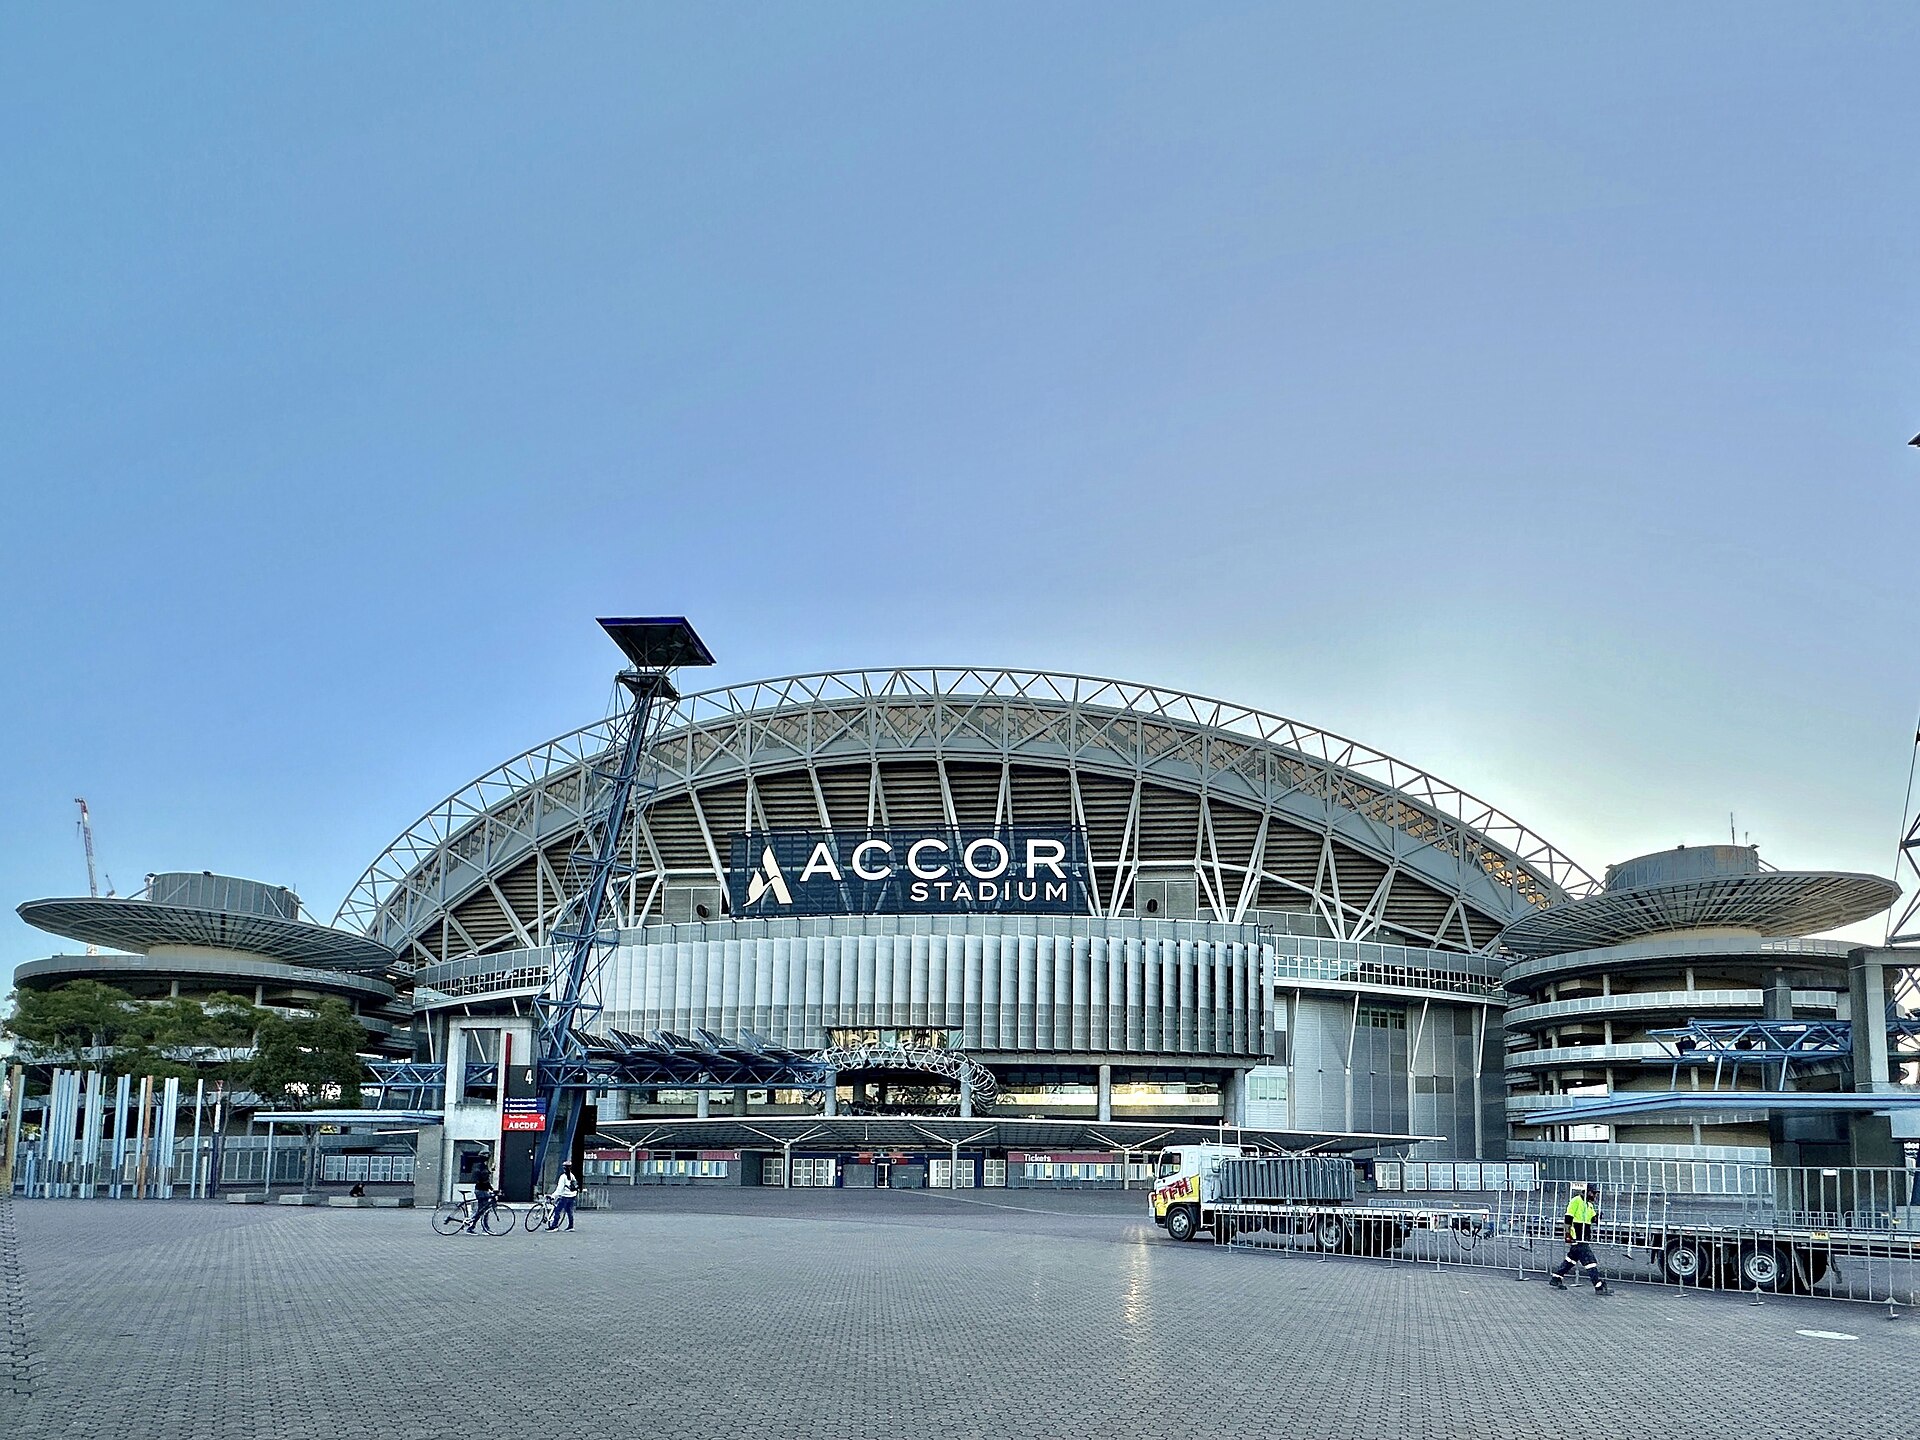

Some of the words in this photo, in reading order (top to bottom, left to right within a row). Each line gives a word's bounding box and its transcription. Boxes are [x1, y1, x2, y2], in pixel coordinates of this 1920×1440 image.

[800, 838, 1067, 882] ACCOR
[910, 882, 1067, 902] STADIUM
[525, 1069, 533, 1084] 4
[508, 1121, 539, 1129] ABCDEF
[1023, 1153, 1052, 1162] Tickets
[1159, 1177, 1193, 1205] TFH
